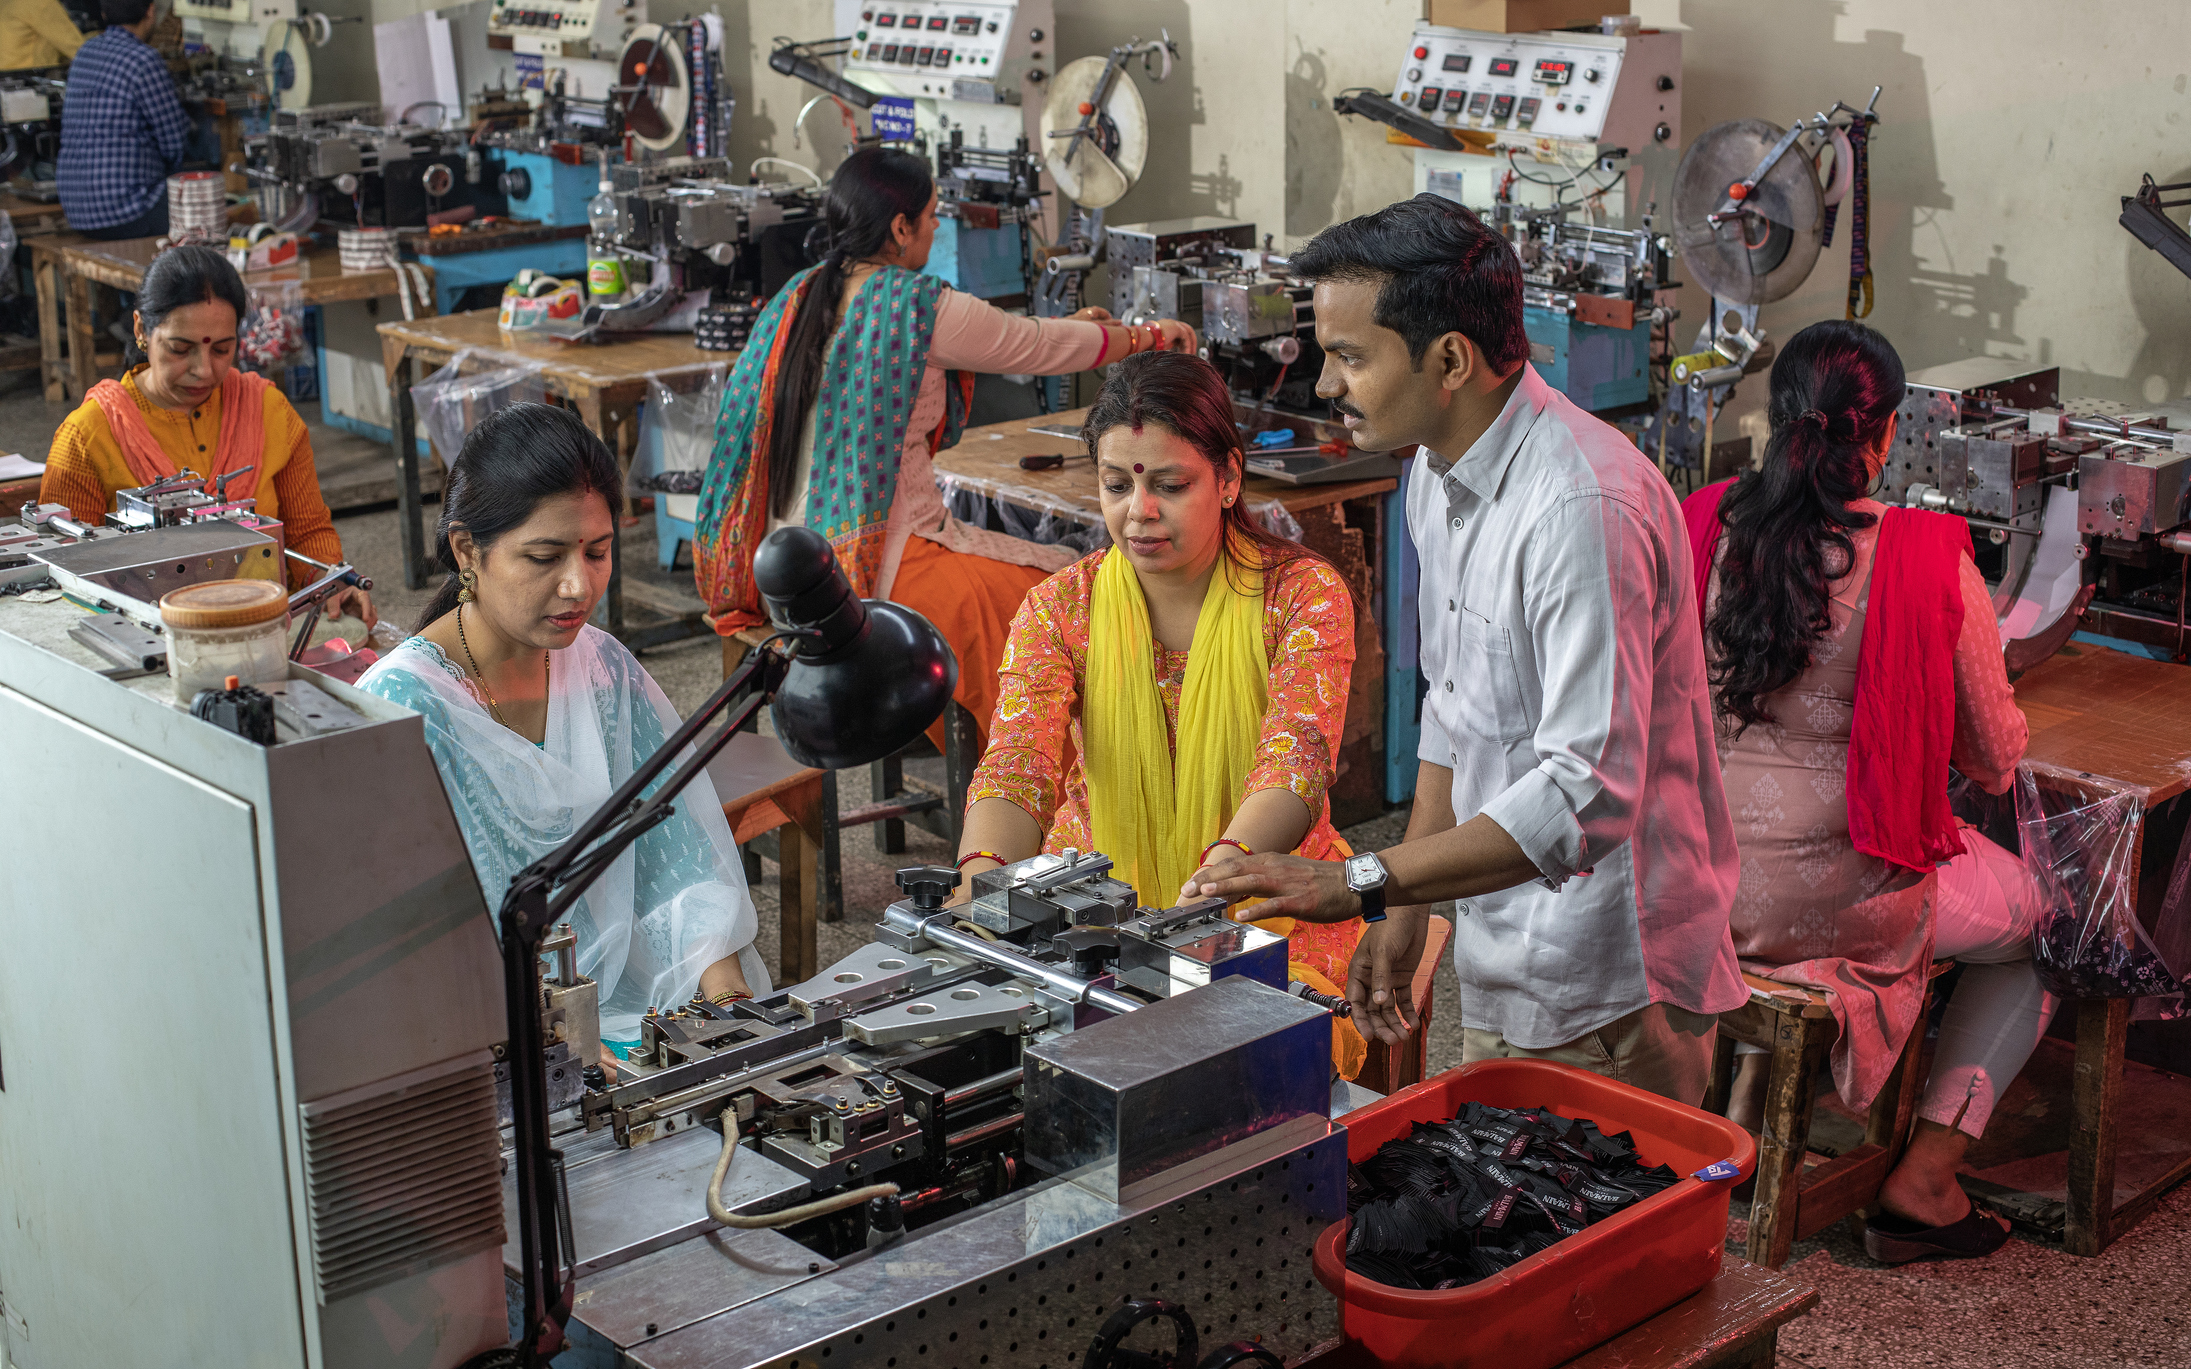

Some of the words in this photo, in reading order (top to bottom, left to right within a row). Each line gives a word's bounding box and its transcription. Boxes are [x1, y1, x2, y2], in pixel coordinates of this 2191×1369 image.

[1471, 1128, 1506, 1144] BALMAIN
[1430, 1141, 1467, 1157] BALMAIN
[1542, 1194, 1571, 1210] LMAIN
[1579, 1187, 1621, 1202] BALMAIN
[1493, 1194, 1513, 1221] BALMAIN
